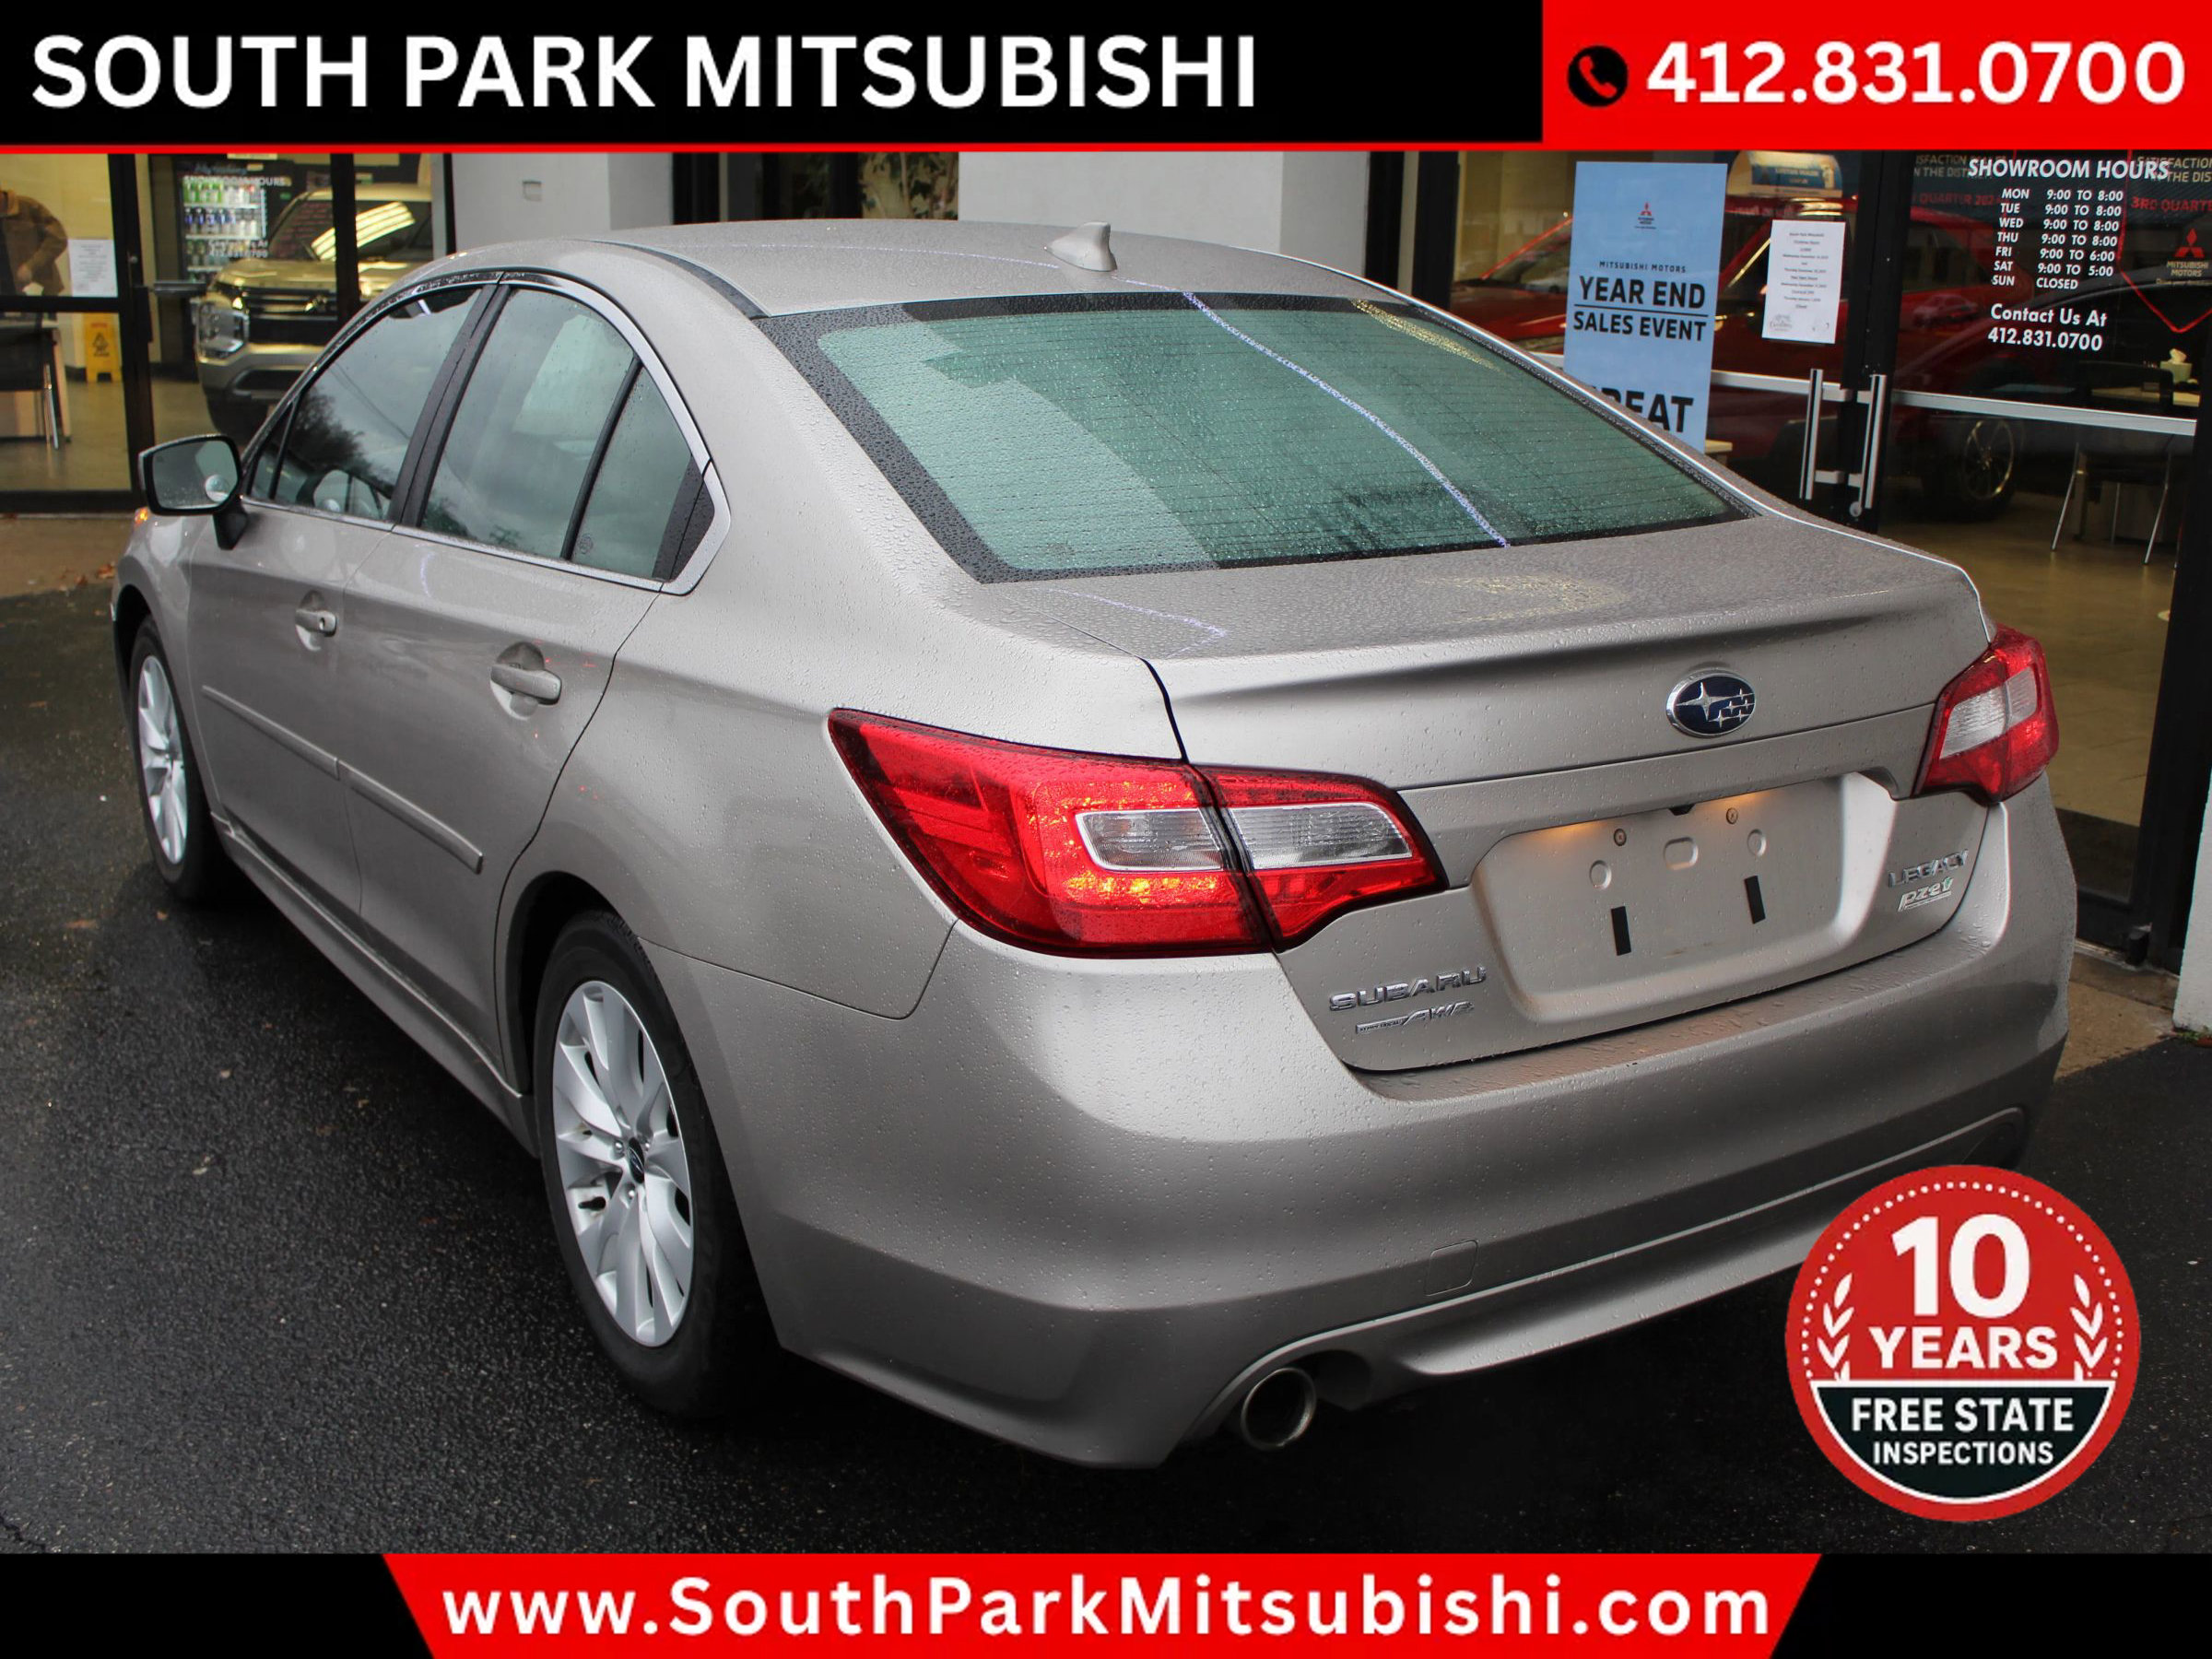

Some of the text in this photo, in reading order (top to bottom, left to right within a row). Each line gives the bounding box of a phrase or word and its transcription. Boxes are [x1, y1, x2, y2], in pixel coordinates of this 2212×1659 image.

[1968, 159, 2089, 179] SHOWROOM
[2096, 159, 2170, 180] HOURS
[2168, 171, 2189, 182] THE
[2001, 189, 2124, 202] MON 9:00 TO 8:00
[2000, 203, 2122, 217] TUE 9:00 TO 8:00
[1999, 218, 2119, 231] WED 9:00 TO 8:00
[1997, 232, 2118, 247] THU 9:00 TO 8:00
[1995, 246, 2115, 262] FRI 9:00 TO 6:00
[1599, 261, 1687, 274] MITSUBISHI MOTORS
[1994, 261, 2113, 276] SAT 9:00 TO 5:00
[2171, 268, 2203, 277] MOTORS
[1992, 276, 2078, 289] SUN CLOSED
[1579, 276, 1706, 309] YEAR END
[1991, 303, 2107, 327] Contact Us At
[1572, 311, 1708, 341] SALES EVENT
[1987, 327, 2103, 351] 412.831.0700
[1888, 848, 1970, 888] LEGACY
[1329, 966, 1488, 1012] SUBARU
